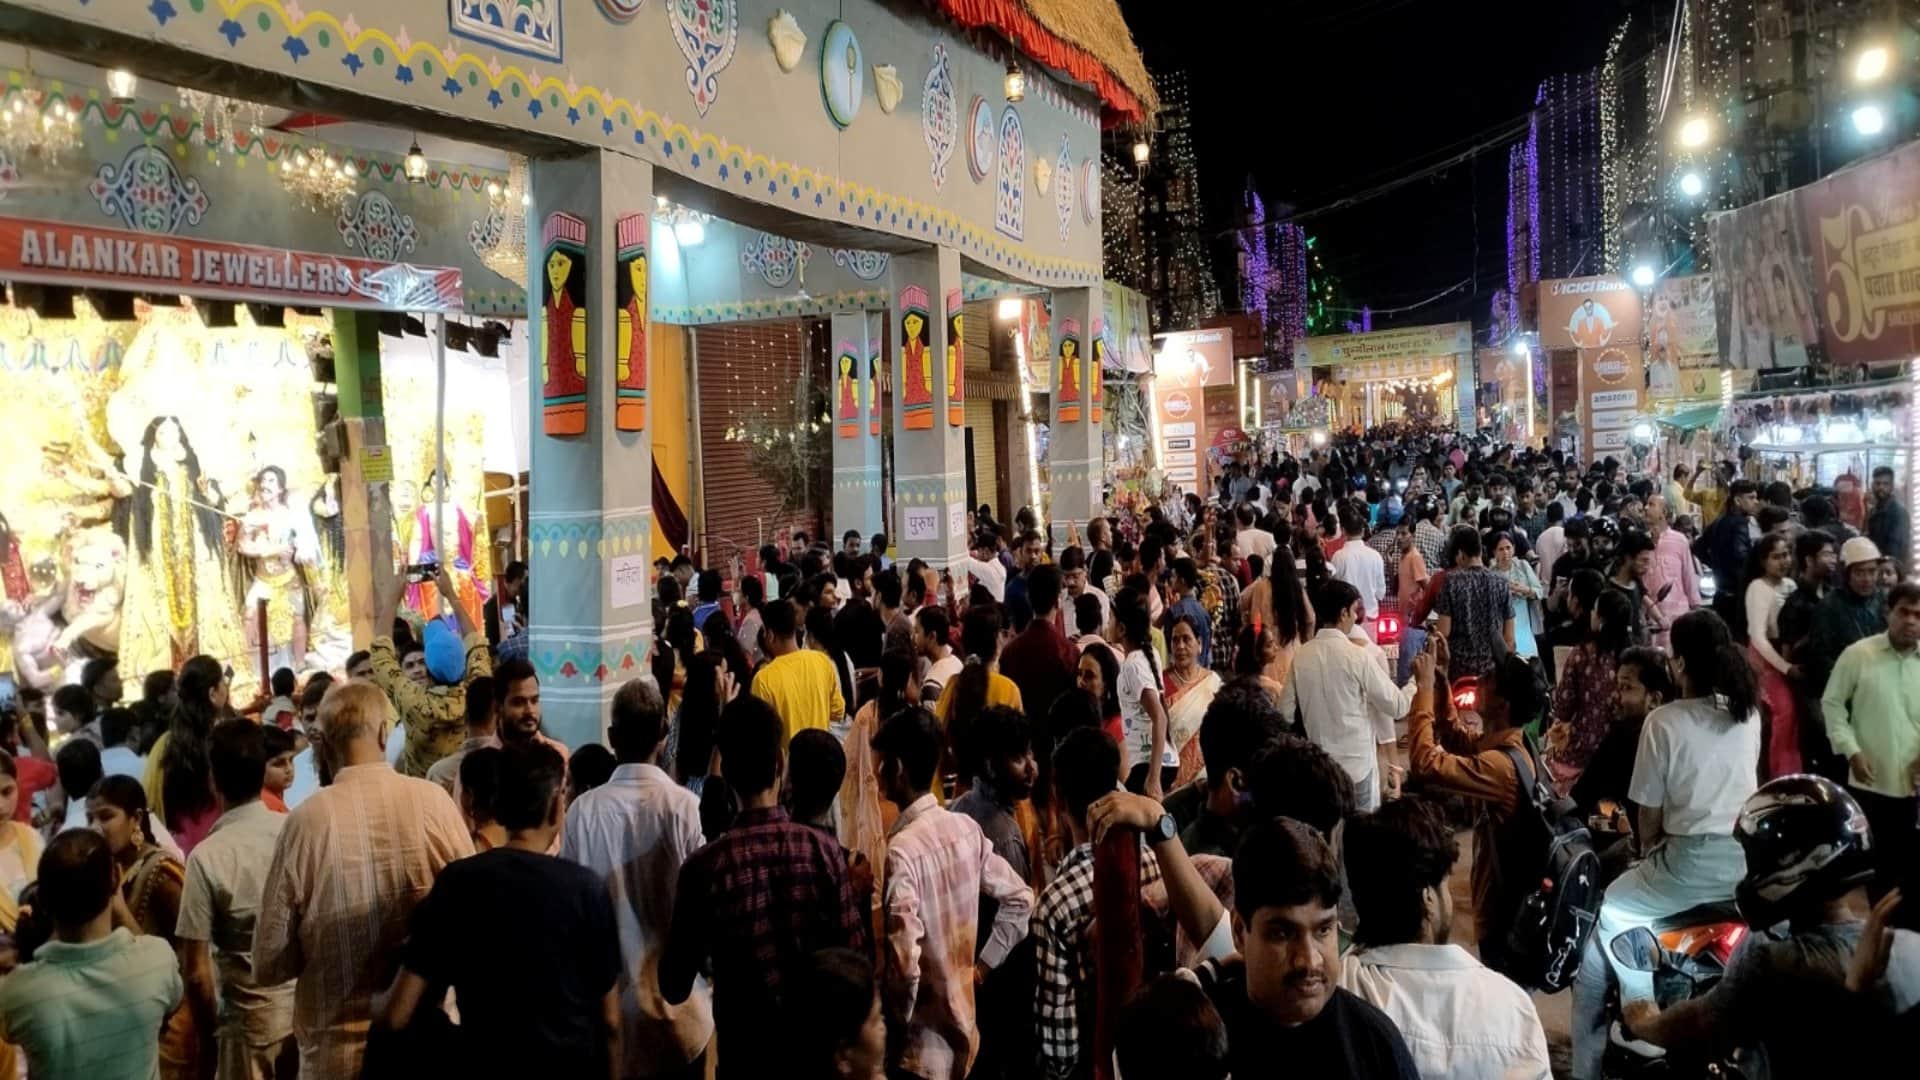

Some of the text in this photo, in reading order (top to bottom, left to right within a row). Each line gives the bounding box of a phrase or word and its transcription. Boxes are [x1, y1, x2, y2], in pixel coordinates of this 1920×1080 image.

[20, 229, 181, 280] ALANKAR
[191, 248, 351, 295] JEWELLERS
[1562, 281, 1595, 295] ICICI
[909, 516, 935, 536] पुरुष
